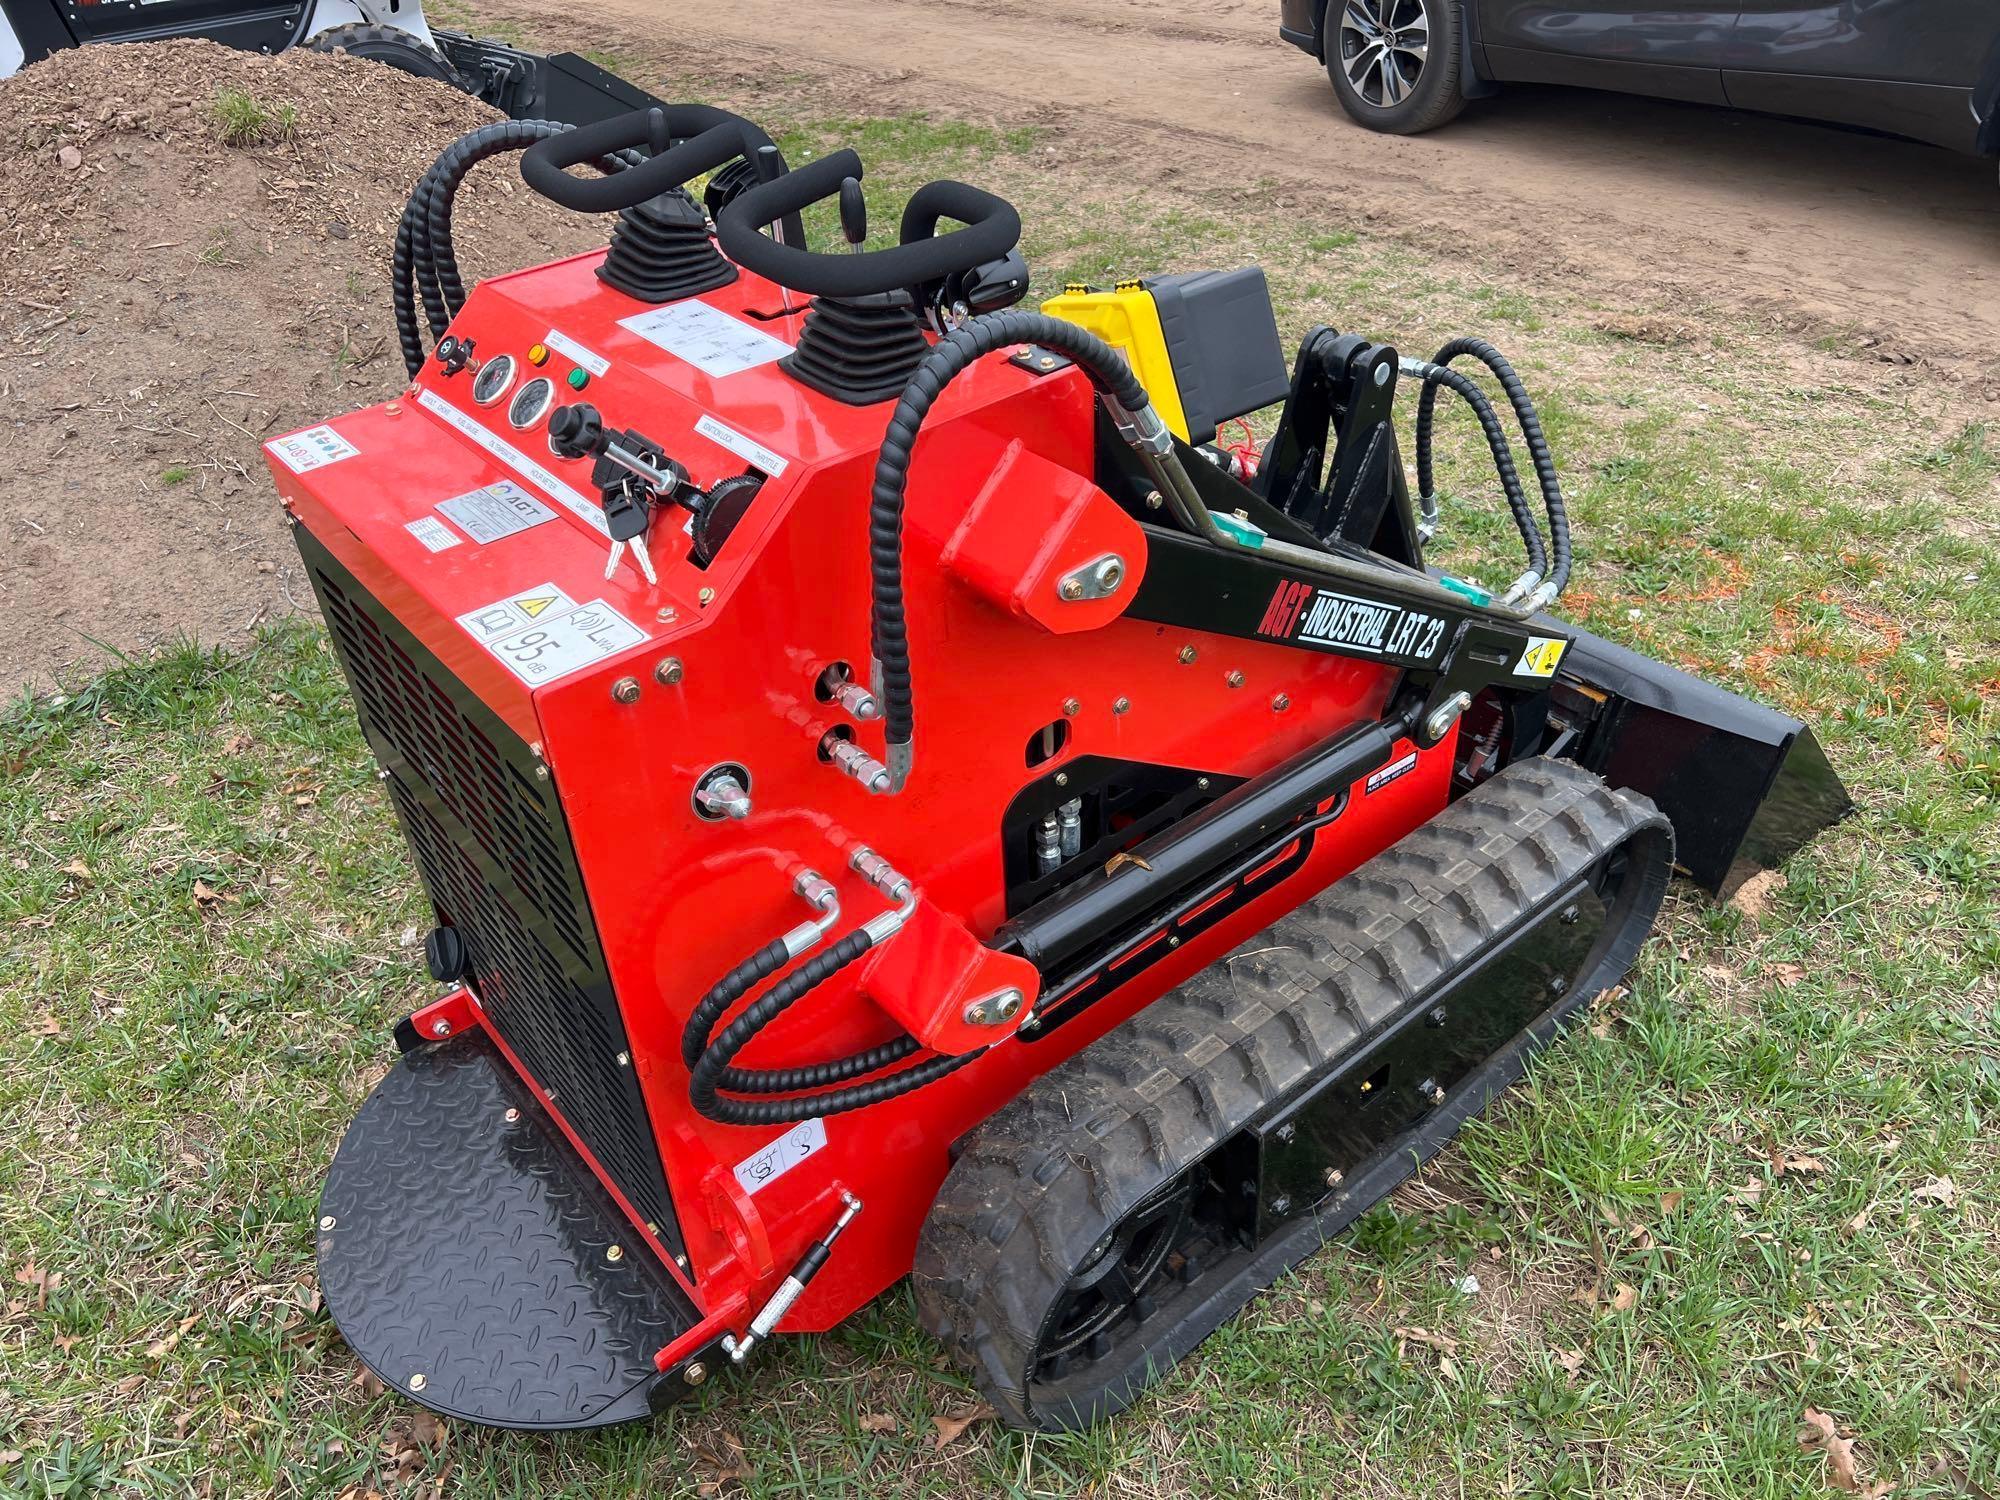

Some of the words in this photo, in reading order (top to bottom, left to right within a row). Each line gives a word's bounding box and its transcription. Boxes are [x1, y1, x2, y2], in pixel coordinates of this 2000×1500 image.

[720, 433, 734, 445] LOCK
[755, 451, 779, 470] THROTTLE
[530, 470, 543, 481] HOUR
[541, 477, 557, 489] METER
[506, 496, 540, 516] AGT
[576, 501, 590, 513] LAMP
[1257, 579, 1312, 638] AGT
[1302, 596, 1392, 647] INDUSTRIAL
[1385, 610, 1429, 656] LRT
[1415, 618, 1445, 659] 23
[503, 631, 561, 661] 95
[527, 661, 549, 675] dB
